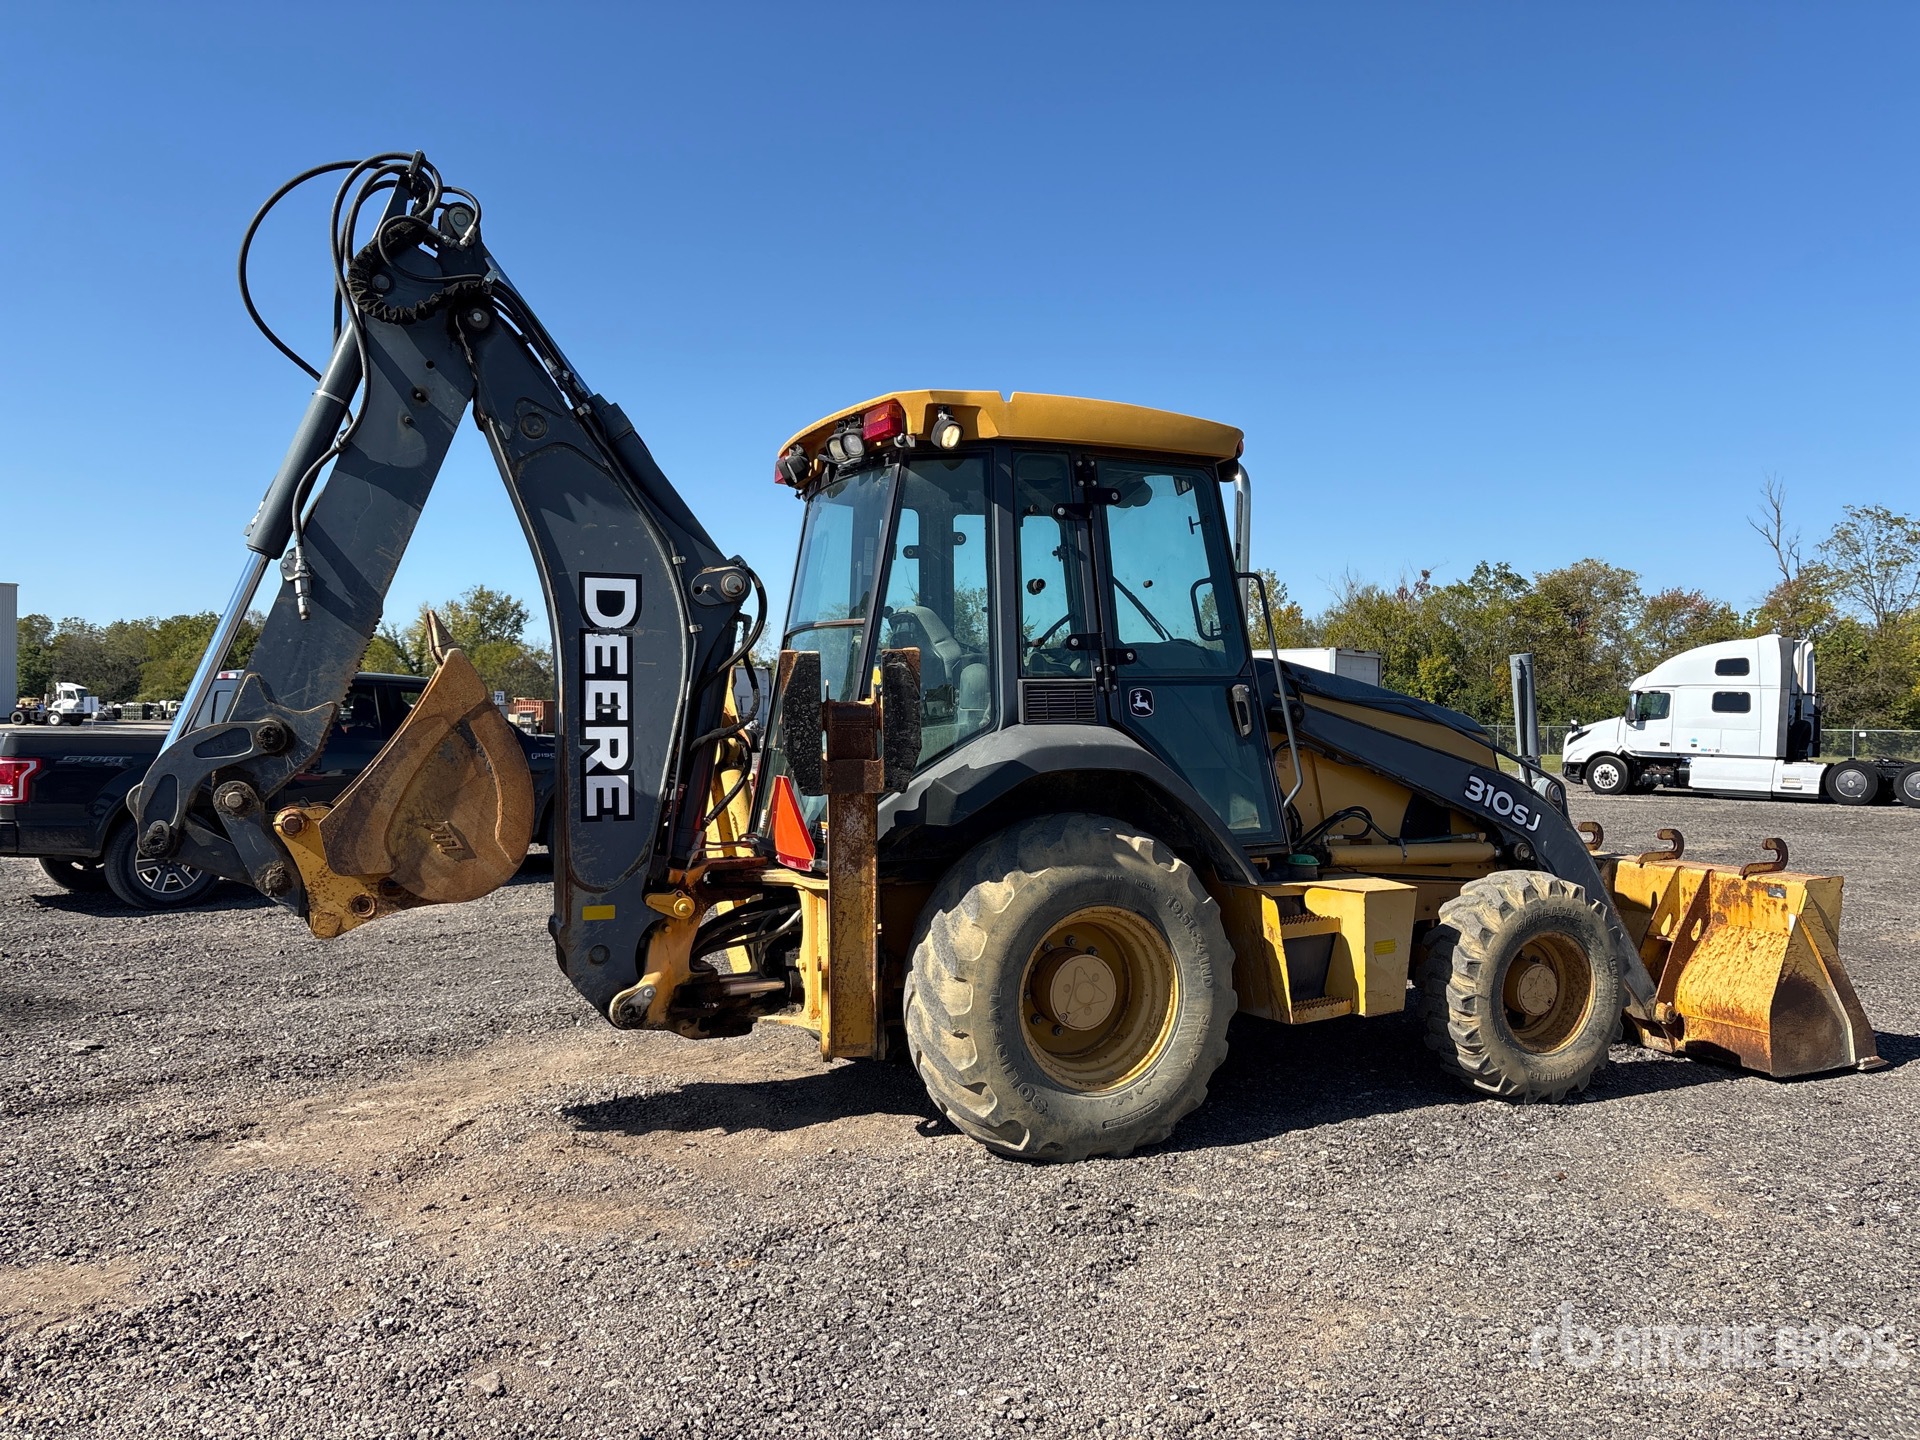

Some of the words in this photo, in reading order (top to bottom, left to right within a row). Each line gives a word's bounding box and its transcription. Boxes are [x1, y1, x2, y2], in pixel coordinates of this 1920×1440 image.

[584, 577, 637, 817] DEERE
[55, 755, 133, 765] SPORT
[1464, 775, 1541, 832] 310SJ
[1515, 906, 1584, 933] CARLISLE
[988, 984, 1049, 1115] SOLIDEAL
